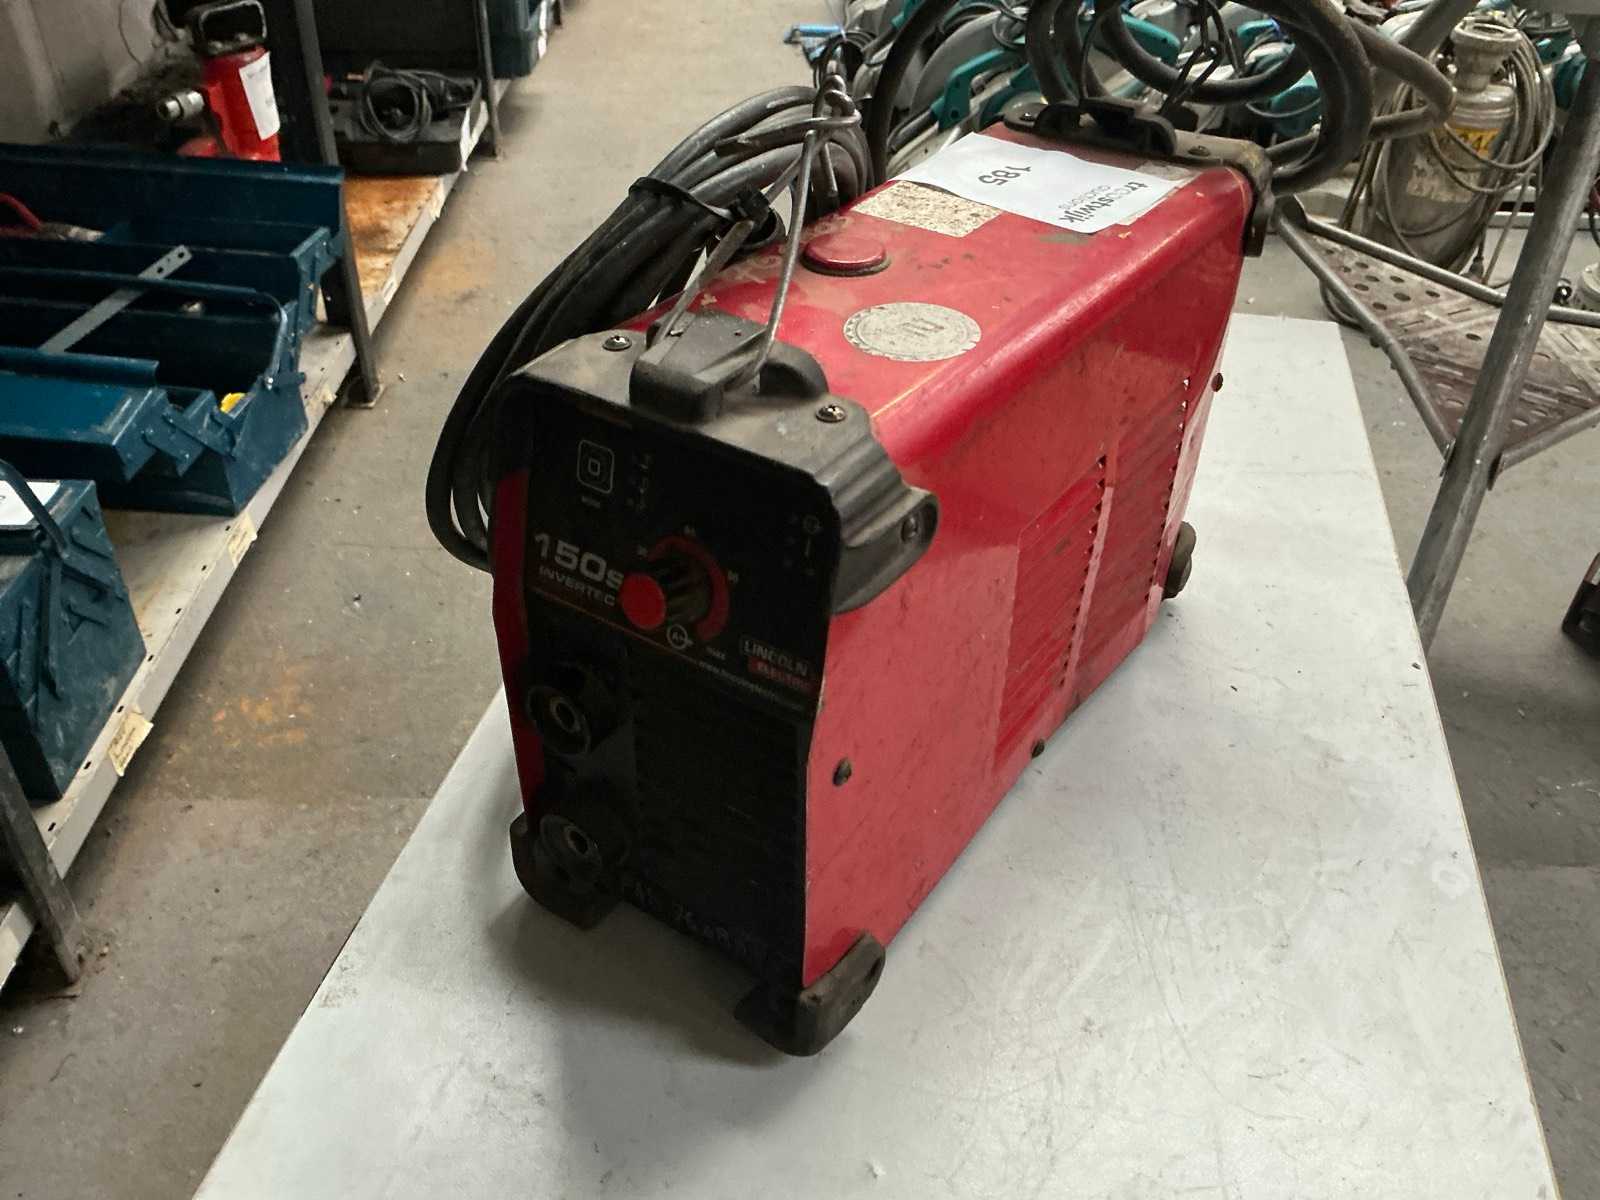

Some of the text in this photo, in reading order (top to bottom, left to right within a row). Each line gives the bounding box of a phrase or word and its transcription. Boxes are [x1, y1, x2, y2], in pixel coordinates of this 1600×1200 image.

[977, 165, 1031, 186] 185
[1058, 181, 1149, 223] troostwijk
[539, 565, 616, 607] INVERTEC
[744, 640, 808, 676] LINCOLN
